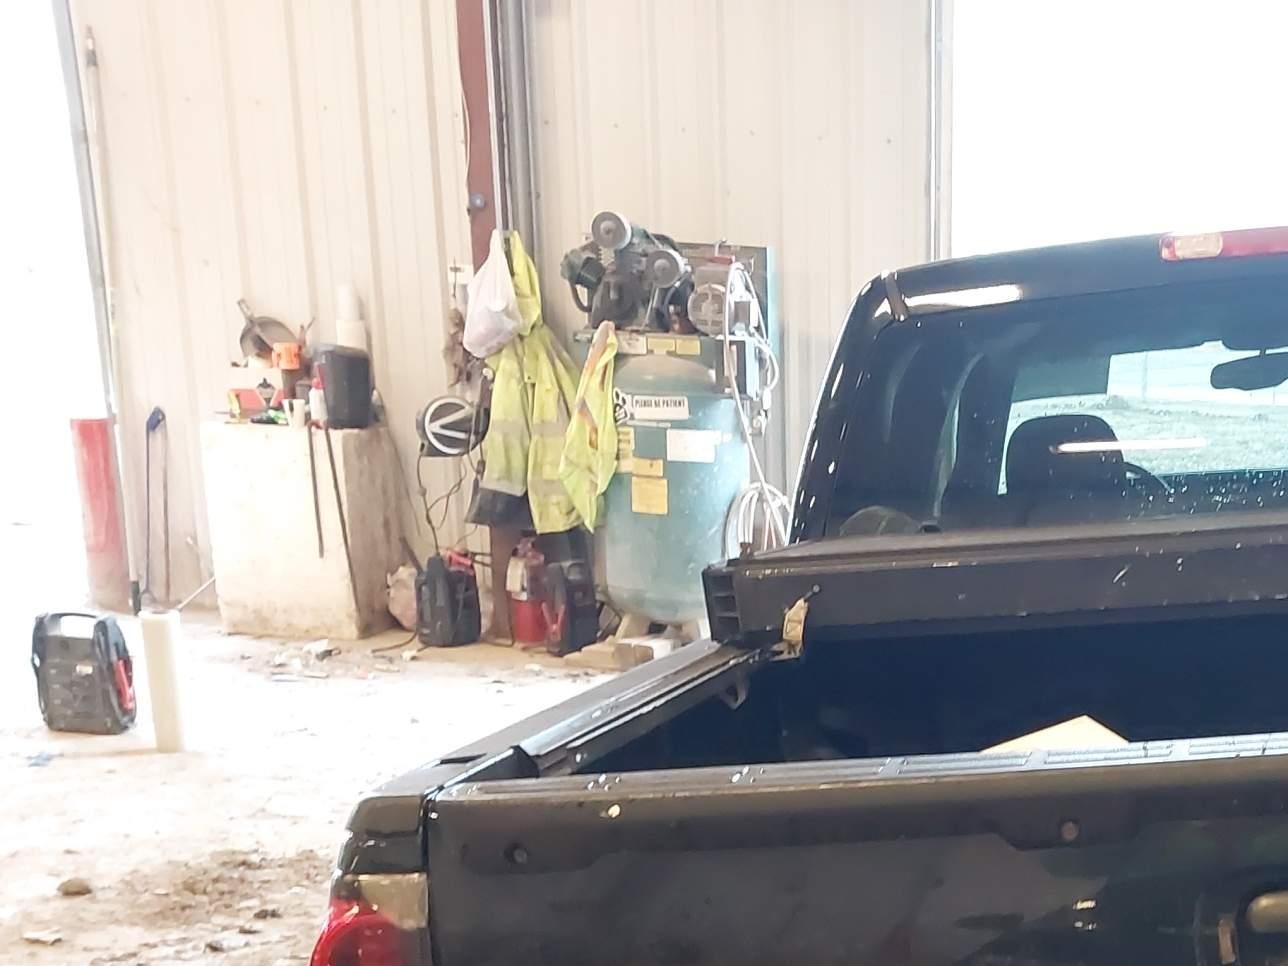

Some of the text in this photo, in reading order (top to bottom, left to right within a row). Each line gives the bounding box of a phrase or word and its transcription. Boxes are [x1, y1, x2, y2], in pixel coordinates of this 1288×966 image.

[635, 399, 685, 408] PLEASE BE PATIENT
